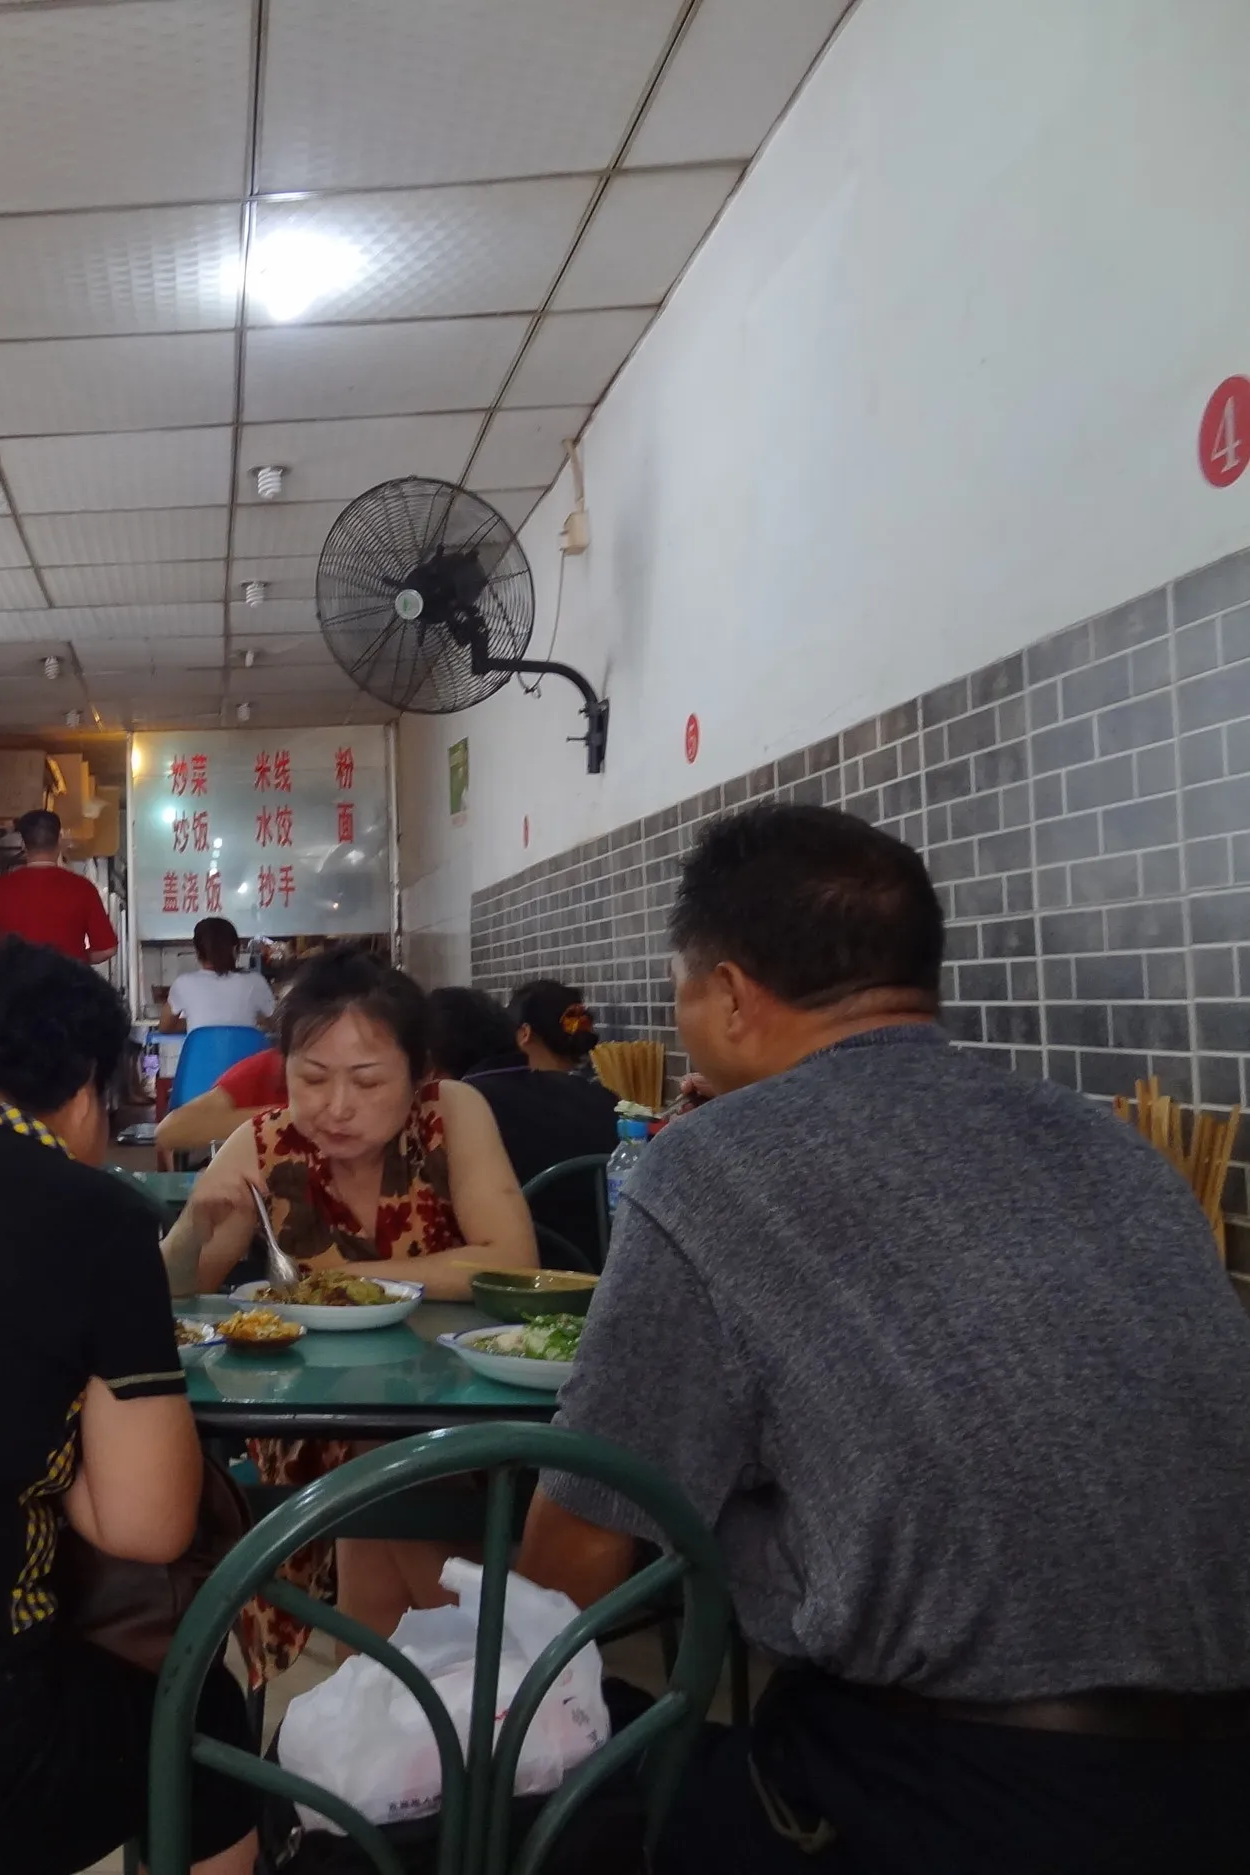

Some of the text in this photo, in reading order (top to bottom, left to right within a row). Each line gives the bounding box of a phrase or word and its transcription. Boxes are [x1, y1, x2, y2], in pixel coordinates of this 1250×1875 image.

[1210, 395, 1241, 474] 4
[168, 746, 355, 797] 炒菜 米线 粉
[172, 802, 355, 854] 炒饭 水饺 面
[162, 864, 296, 914] 盖浇饭 抄手
